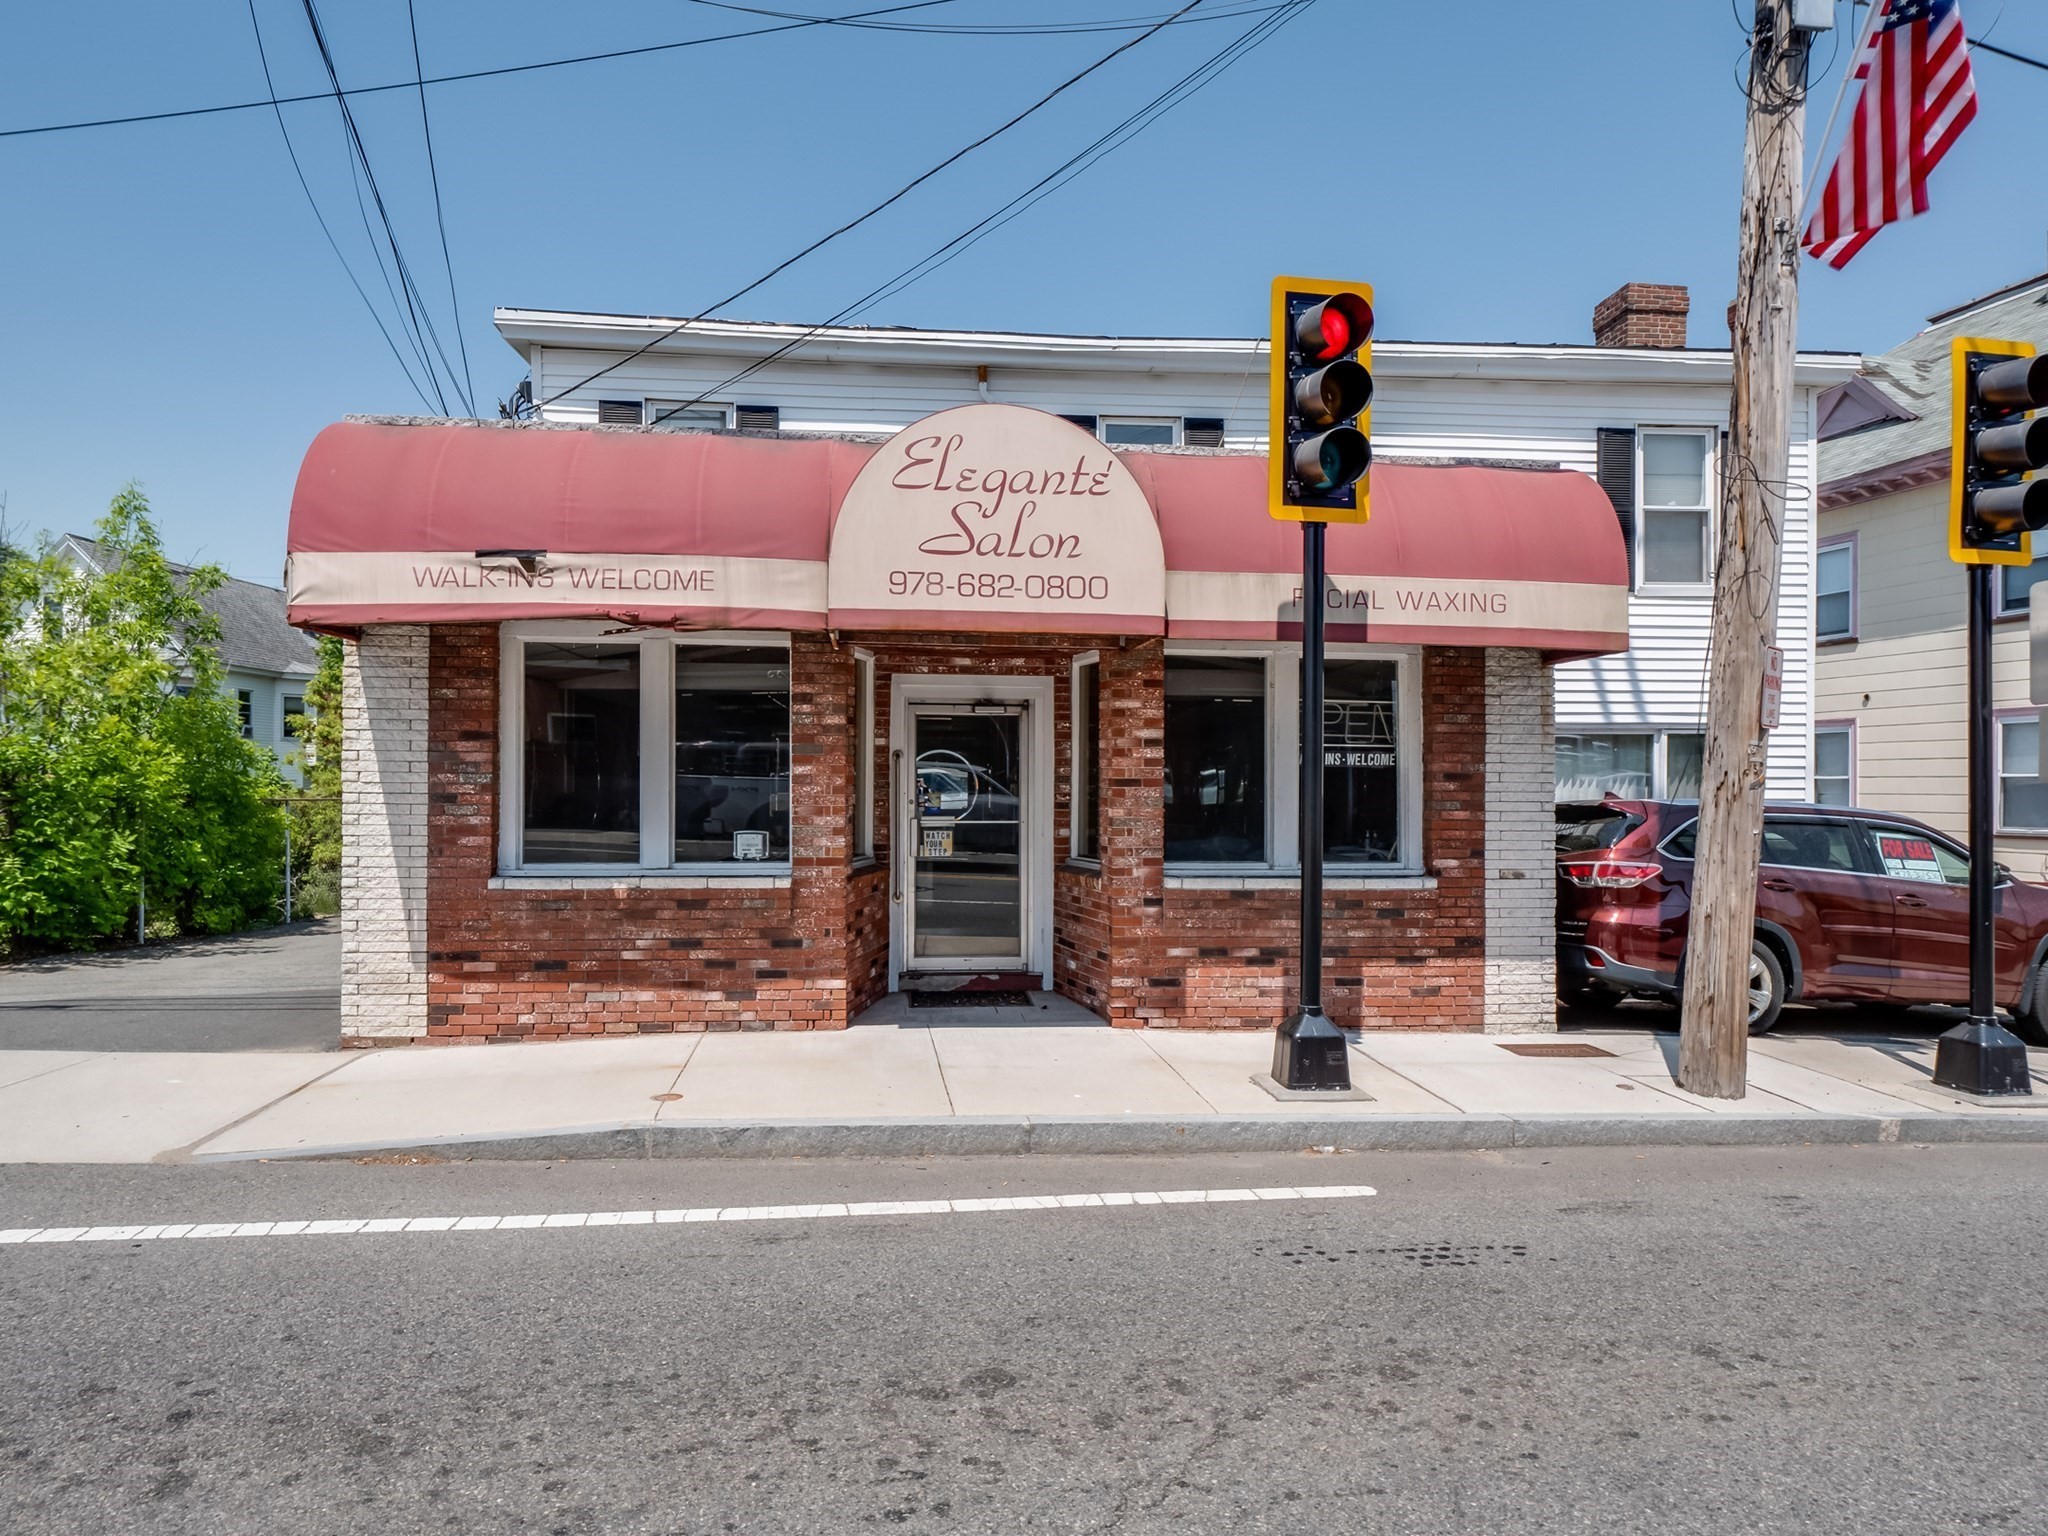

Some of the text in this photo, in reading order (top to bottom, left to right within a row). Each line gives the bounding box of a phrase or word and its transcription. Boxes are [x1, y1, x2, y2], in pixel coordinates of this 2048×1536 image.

[892, 434, 1113, 518] Eleganté
[918, 500, 1083, 558] Salon
[412, 565, 715, 592] WALK-INS WELCOME
[888, 570, 1109, 600] 978-682-0800
[1292, 587, 1507, 613] FCIAL WAXING
[1323, 702, 1395, 744] PEN
[925, 840, 943, 848] YOUR
[928, 848, 948, 857] STEP
[1881, 839, 1934, 860] FOR SALE
